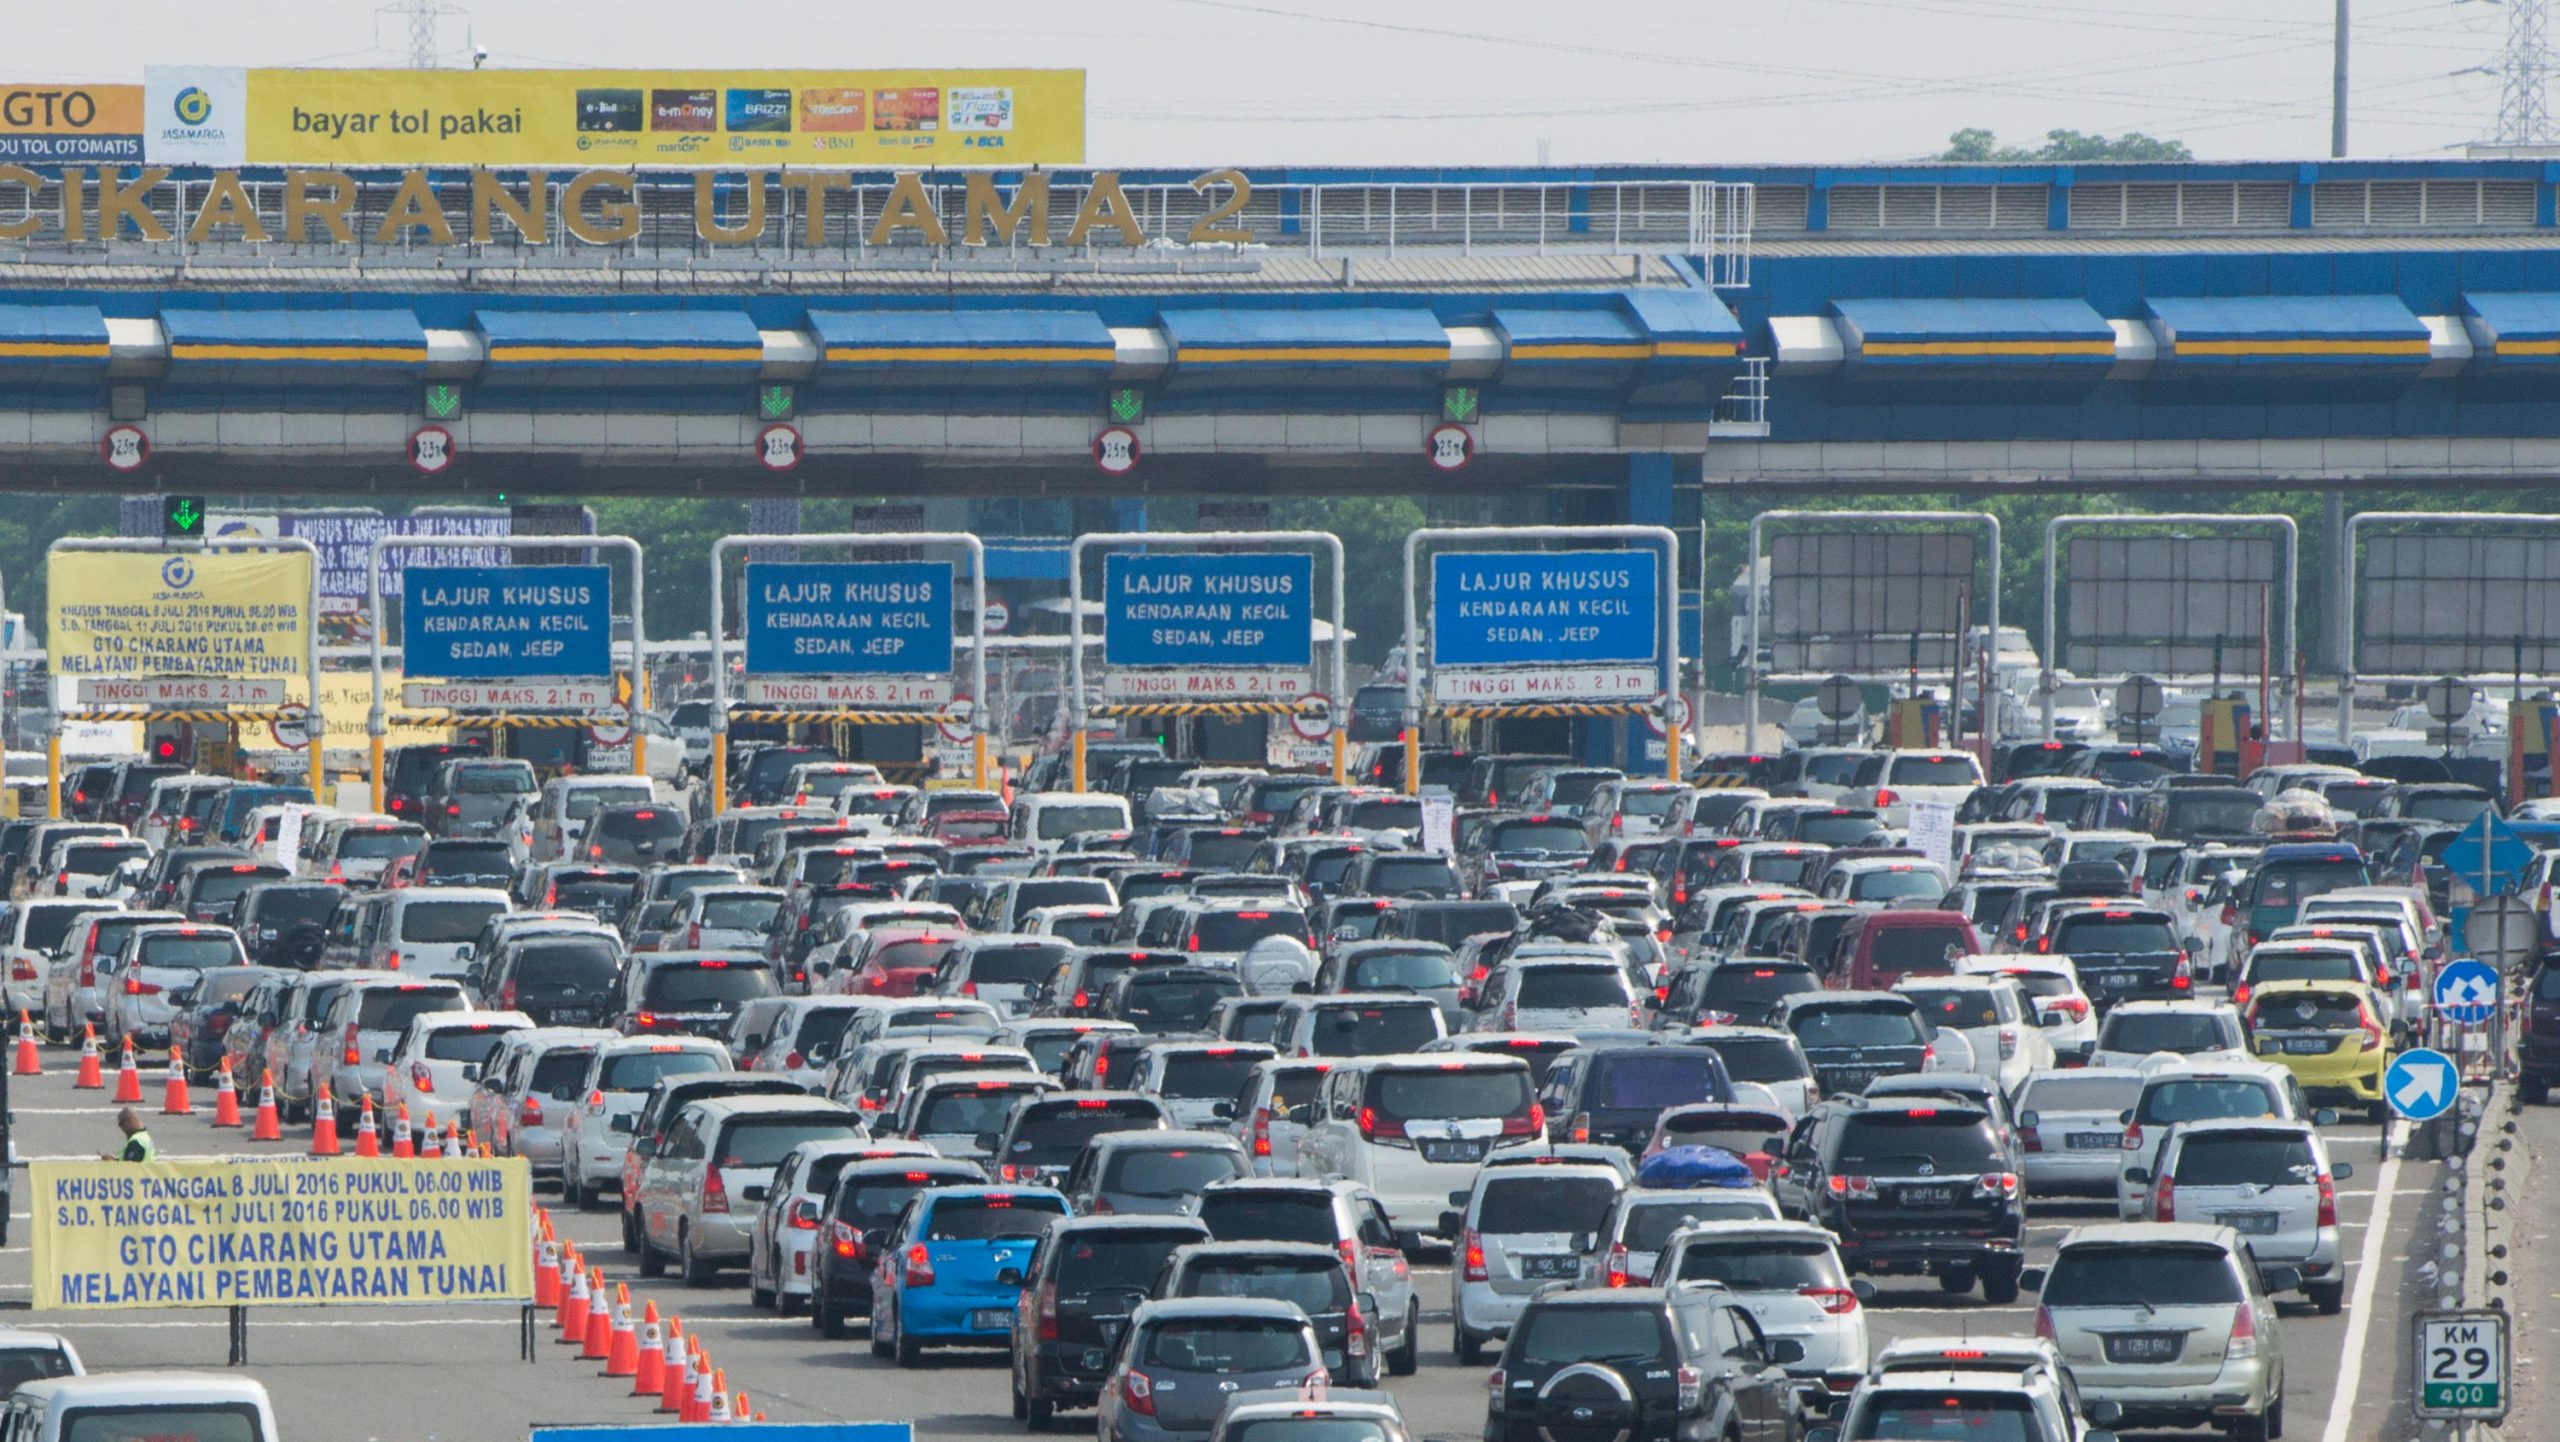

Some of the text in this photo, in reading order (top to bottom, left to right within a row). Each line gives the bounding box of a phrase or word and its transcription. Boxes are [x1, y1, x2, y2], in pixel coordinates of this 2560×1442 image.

[4, 91, 96, 127] GTO
[745, 104, 787, 115] BRIZZI
[293, 107, 521, 140] bayar tol pakai
[162, 128, 225, 139] JASAMARGA
[977, 136, 1004, 147] BCA
[22, 140, 51, 155] TOL
[55, 138, 138, 155] OTOMATIS
[828, 137, 854, 149] BNI
[694, 169, 1145, 248] UTAMA
[1187, 167, 1255, 243] 2
[1124, 574, 1292, 594] LAJUR KHUSUS
[1460, 570, 1629, 591] LAJUR KHUSUS
[422, 586, 590, 606] LAJUR KHUSUS
[765, 582, 931, 603] LAJUR KHUSUS
[61, 605, 101, 617] KHUSUS
[104, 605, 150, 617] TANGGAL
[278, 604, 298, 618] WIB
[1127, 604, 1289, 620] KENDARAAN KECIL
[1460, 600, 1630, 617] KENDARAAN KECIL
[84, 619, 133, 631] TANGGAL
[150, 619, 175, 631] JULI
[206, 618, 243, 631] PUKUL
[276, 618, 297, 631] WIB
[424, 615, 589, 632] KENDARAAN KECIL
[767, 612, 930, 628] KENDARAAN KECIL
[1152, 629, 1264, 646] SEDAN, JEEP
[1559, 626, 1599, 641] JEEP
[93, 636, 265, 654] GTO CIKARANG UTAMA
[450, 640, 564, 659] SEDAN, JEEP
[862, 638, 904, 655] JEEP
[61, 655, 298, 672] MELAYANI PEMBAYARAN TUNAI
[94, 685, 148, 698] TINGGI
[252, 687, 268, 698] m
[1122, 677, 1177, 691] TINGGI
[1280, 680, 1298, 691] m
[1450, 677, 1516, 694] TINGGI
[421, 689, 477, 704] TINGGI
[579, 690, 595, 704] m
[762, 686, 818, 700] TINGGI
[919, 689, 935, 701] m
[57, 1170, 502, 1200] KHUSUS TANGGAL 8 JULI 2016 PUKUL 06.00 WIB
[58, 1197, 503, 1227] S.D. TANGGAL 11 JULI 2016 PUKUL 06.00 WIB
[120, 1230, 446, 1266] GTO CIKARANG UTAMA
[62, 1264, 505, 1304] MELAYANI PEMBAYARAN TUNAI
[2444, 1326, 2478, 1344] KM
[2113, 1339, 2120, 1352] B
[2432, 1347, 2490, 1380] 29
[2440, 1386, 2483, 1404] 400
